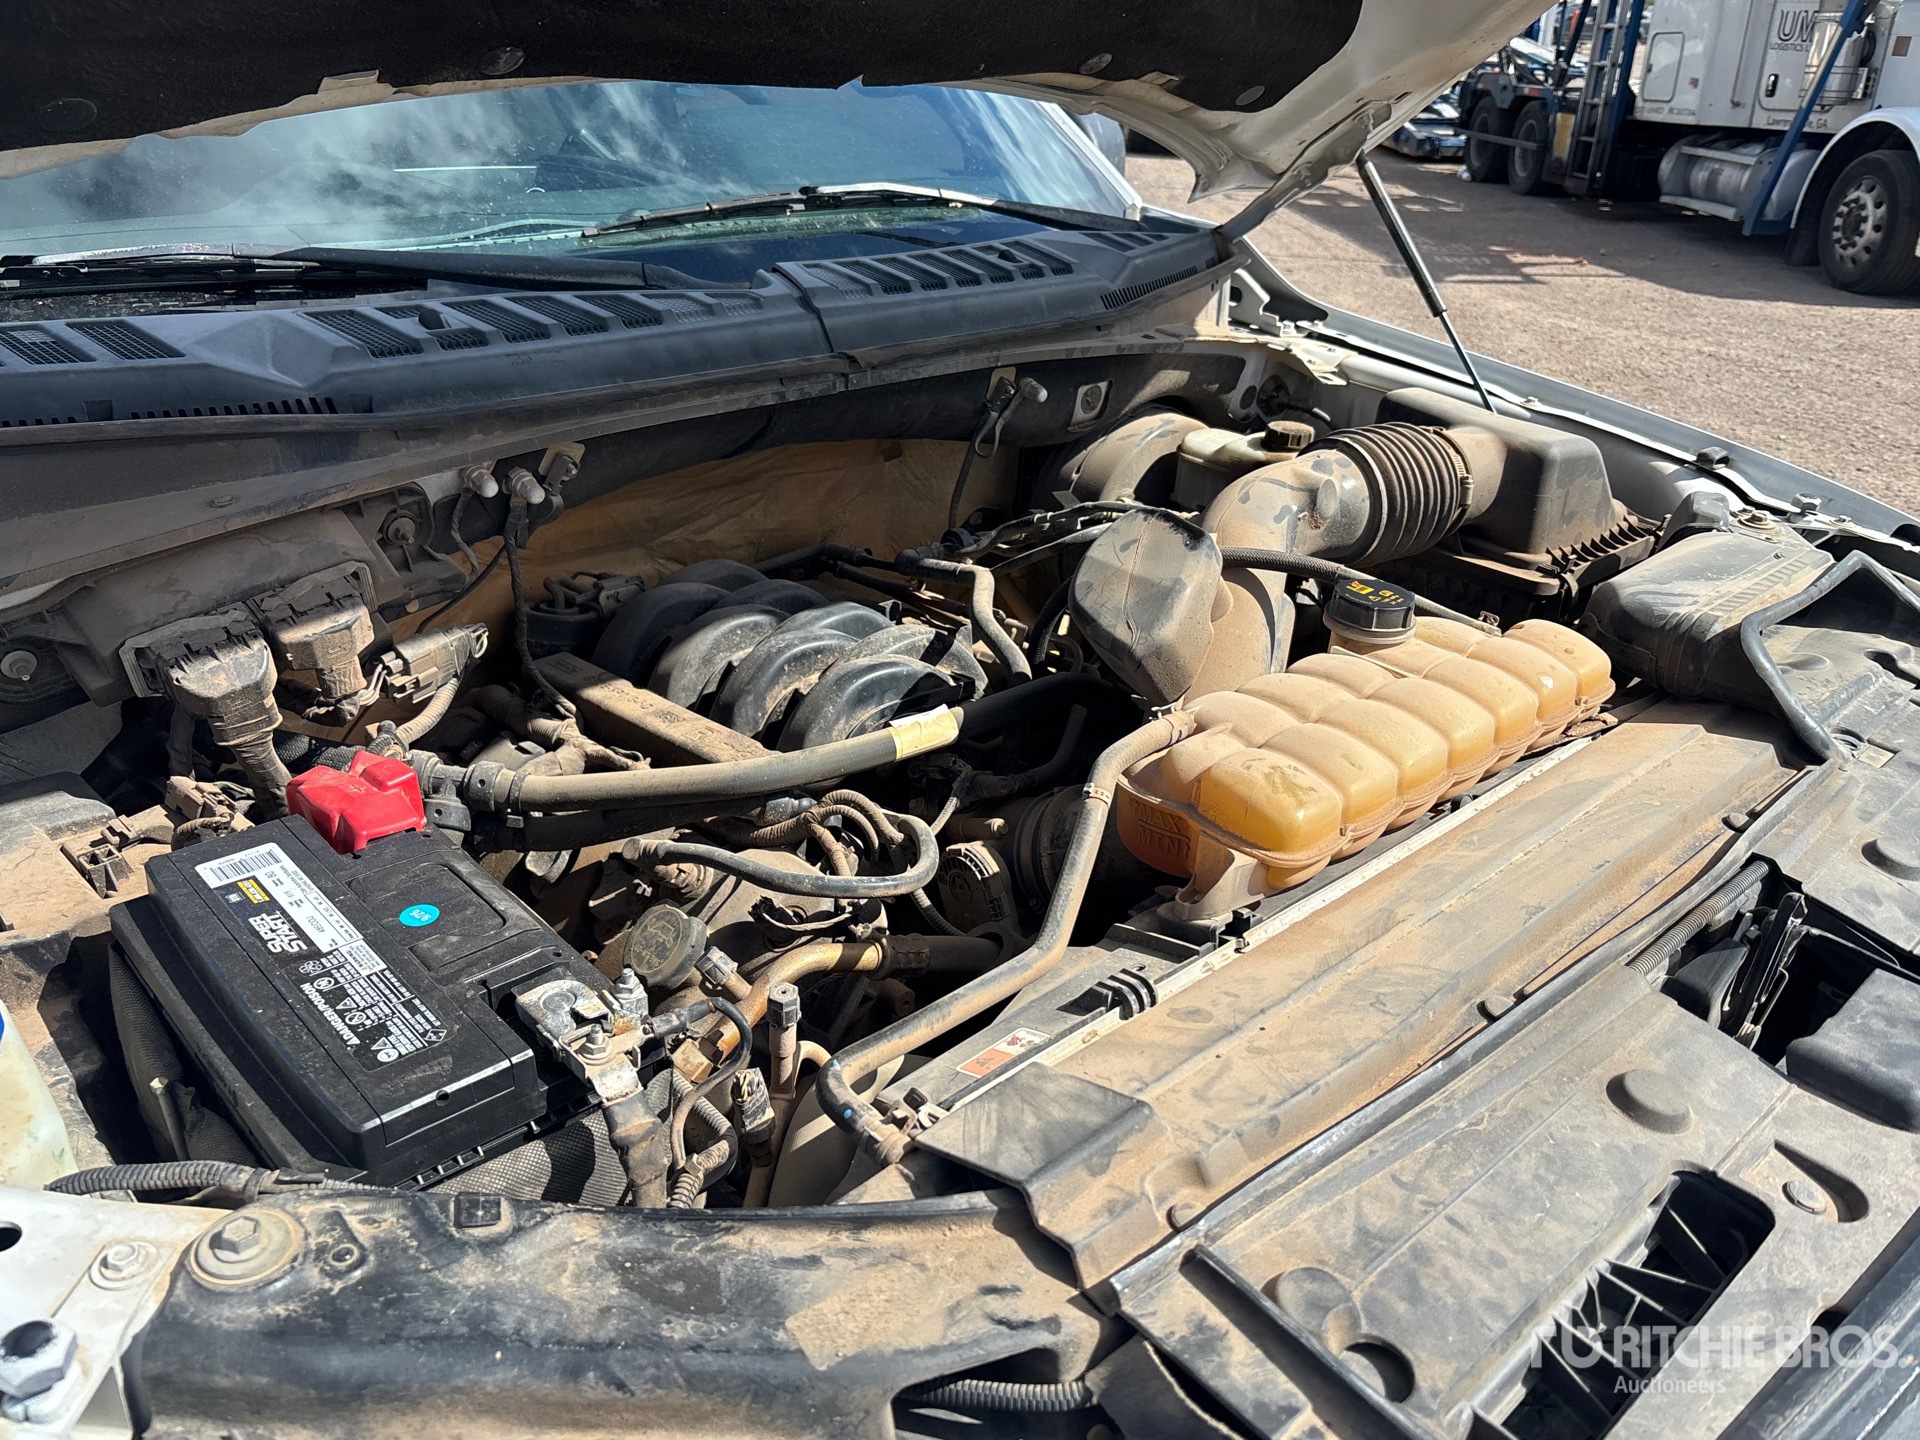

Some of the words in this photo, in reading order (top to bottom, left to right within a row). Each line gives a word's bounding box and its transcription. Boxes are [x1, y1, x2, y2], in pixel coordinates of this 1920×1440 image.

[1769, 42, 1804, 52] LOGISTICS
[1815, 118, 1828, 129] GA
[1140, 803, 1183, 833] MAX
[1138, 825, 1180, 855] MIN
[247, 915, 289, 952] SUPER
[260, 914, 308, 952] START
[299, 982, 355, 1039] DANGER/POISON
